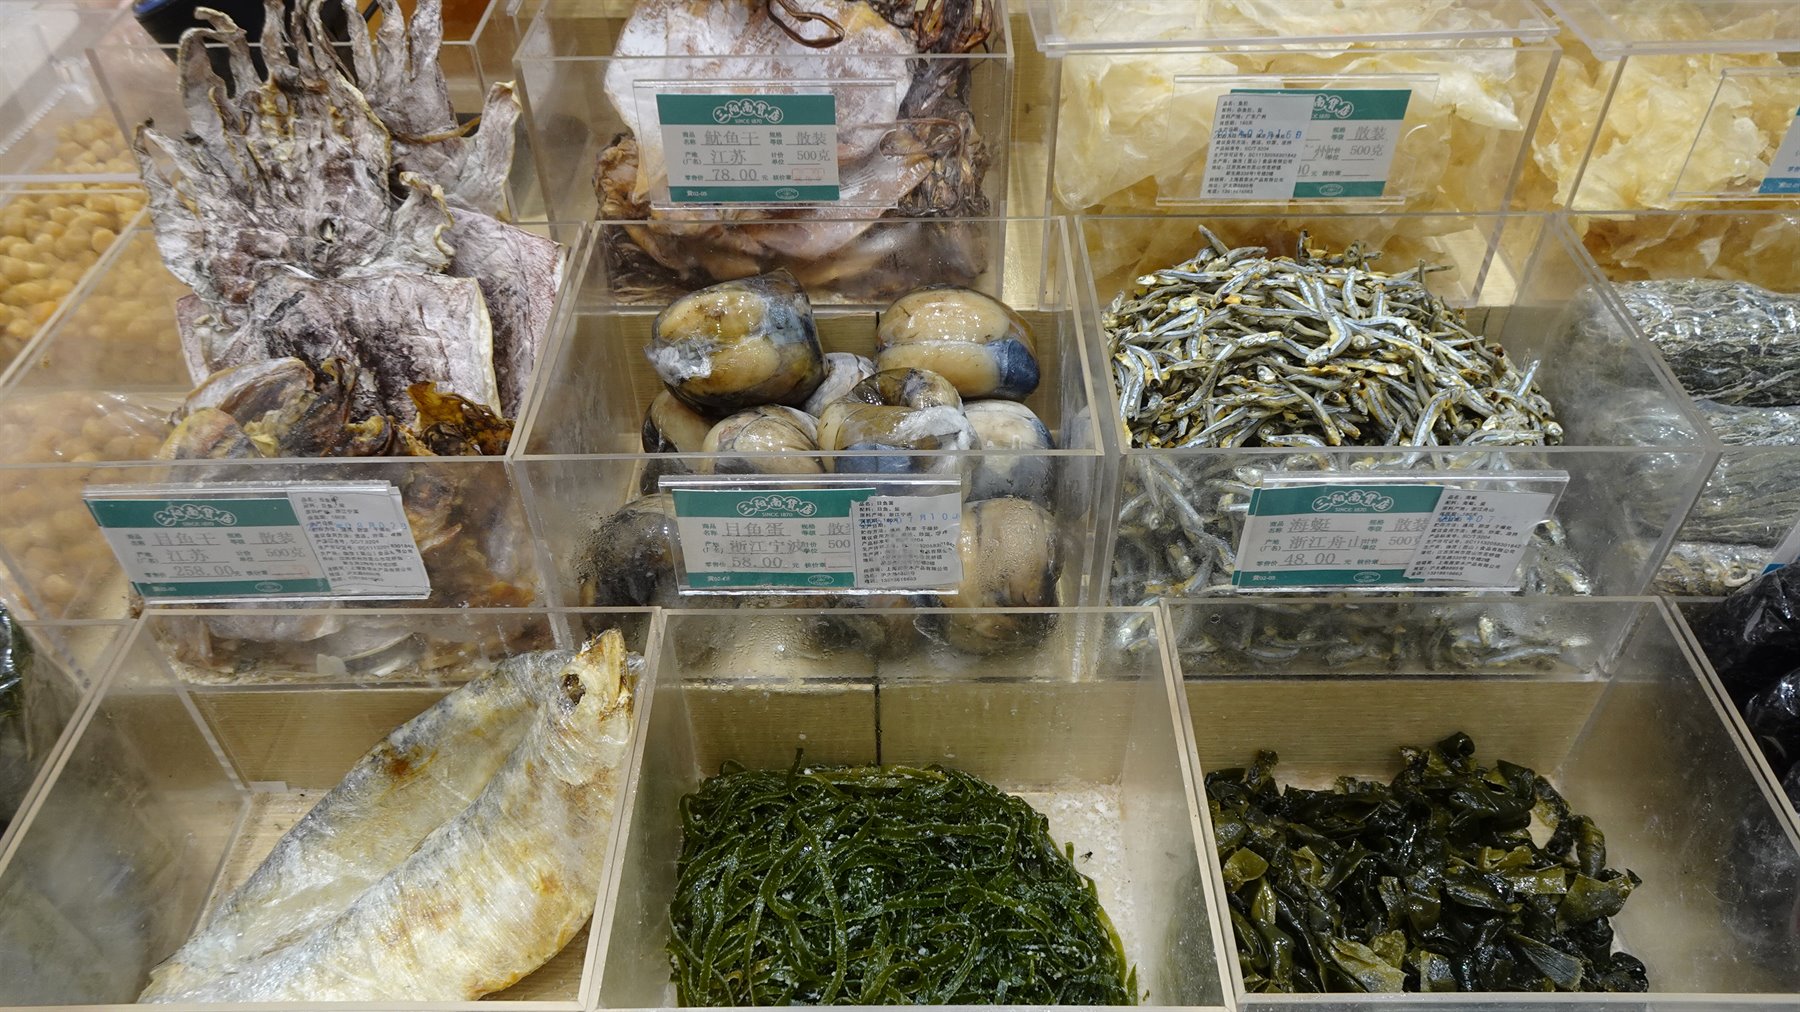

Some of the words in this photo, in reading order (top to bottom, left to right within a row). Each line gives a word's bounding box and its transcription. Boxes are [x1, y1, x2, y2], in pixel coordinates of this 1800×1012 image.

[705, 130, 760, 146] 鱿鱼干
[796, 131, 828, 146] 散装
[1354, 126, 1386, 141] 散装
[710, 149, 748, 165] 江苏
[796, 149, 831, 162] 500克
[1349, 144, 1384, 157] 500克
[711, 168, 758, 182] 78.00
[258, 532, 297, 546] 散装
[828, 539, 851, 549] 500
[1289, 535, 1363, 550] 浙江舟山
[165, 549, 210, 563] 江苏
[265, 546, 307, 559] 500克
[1284, 552, 1336, 567] 48.00
[731, 557, 783, 569] 58.00
[173, 565, 234, 578] 258.00
